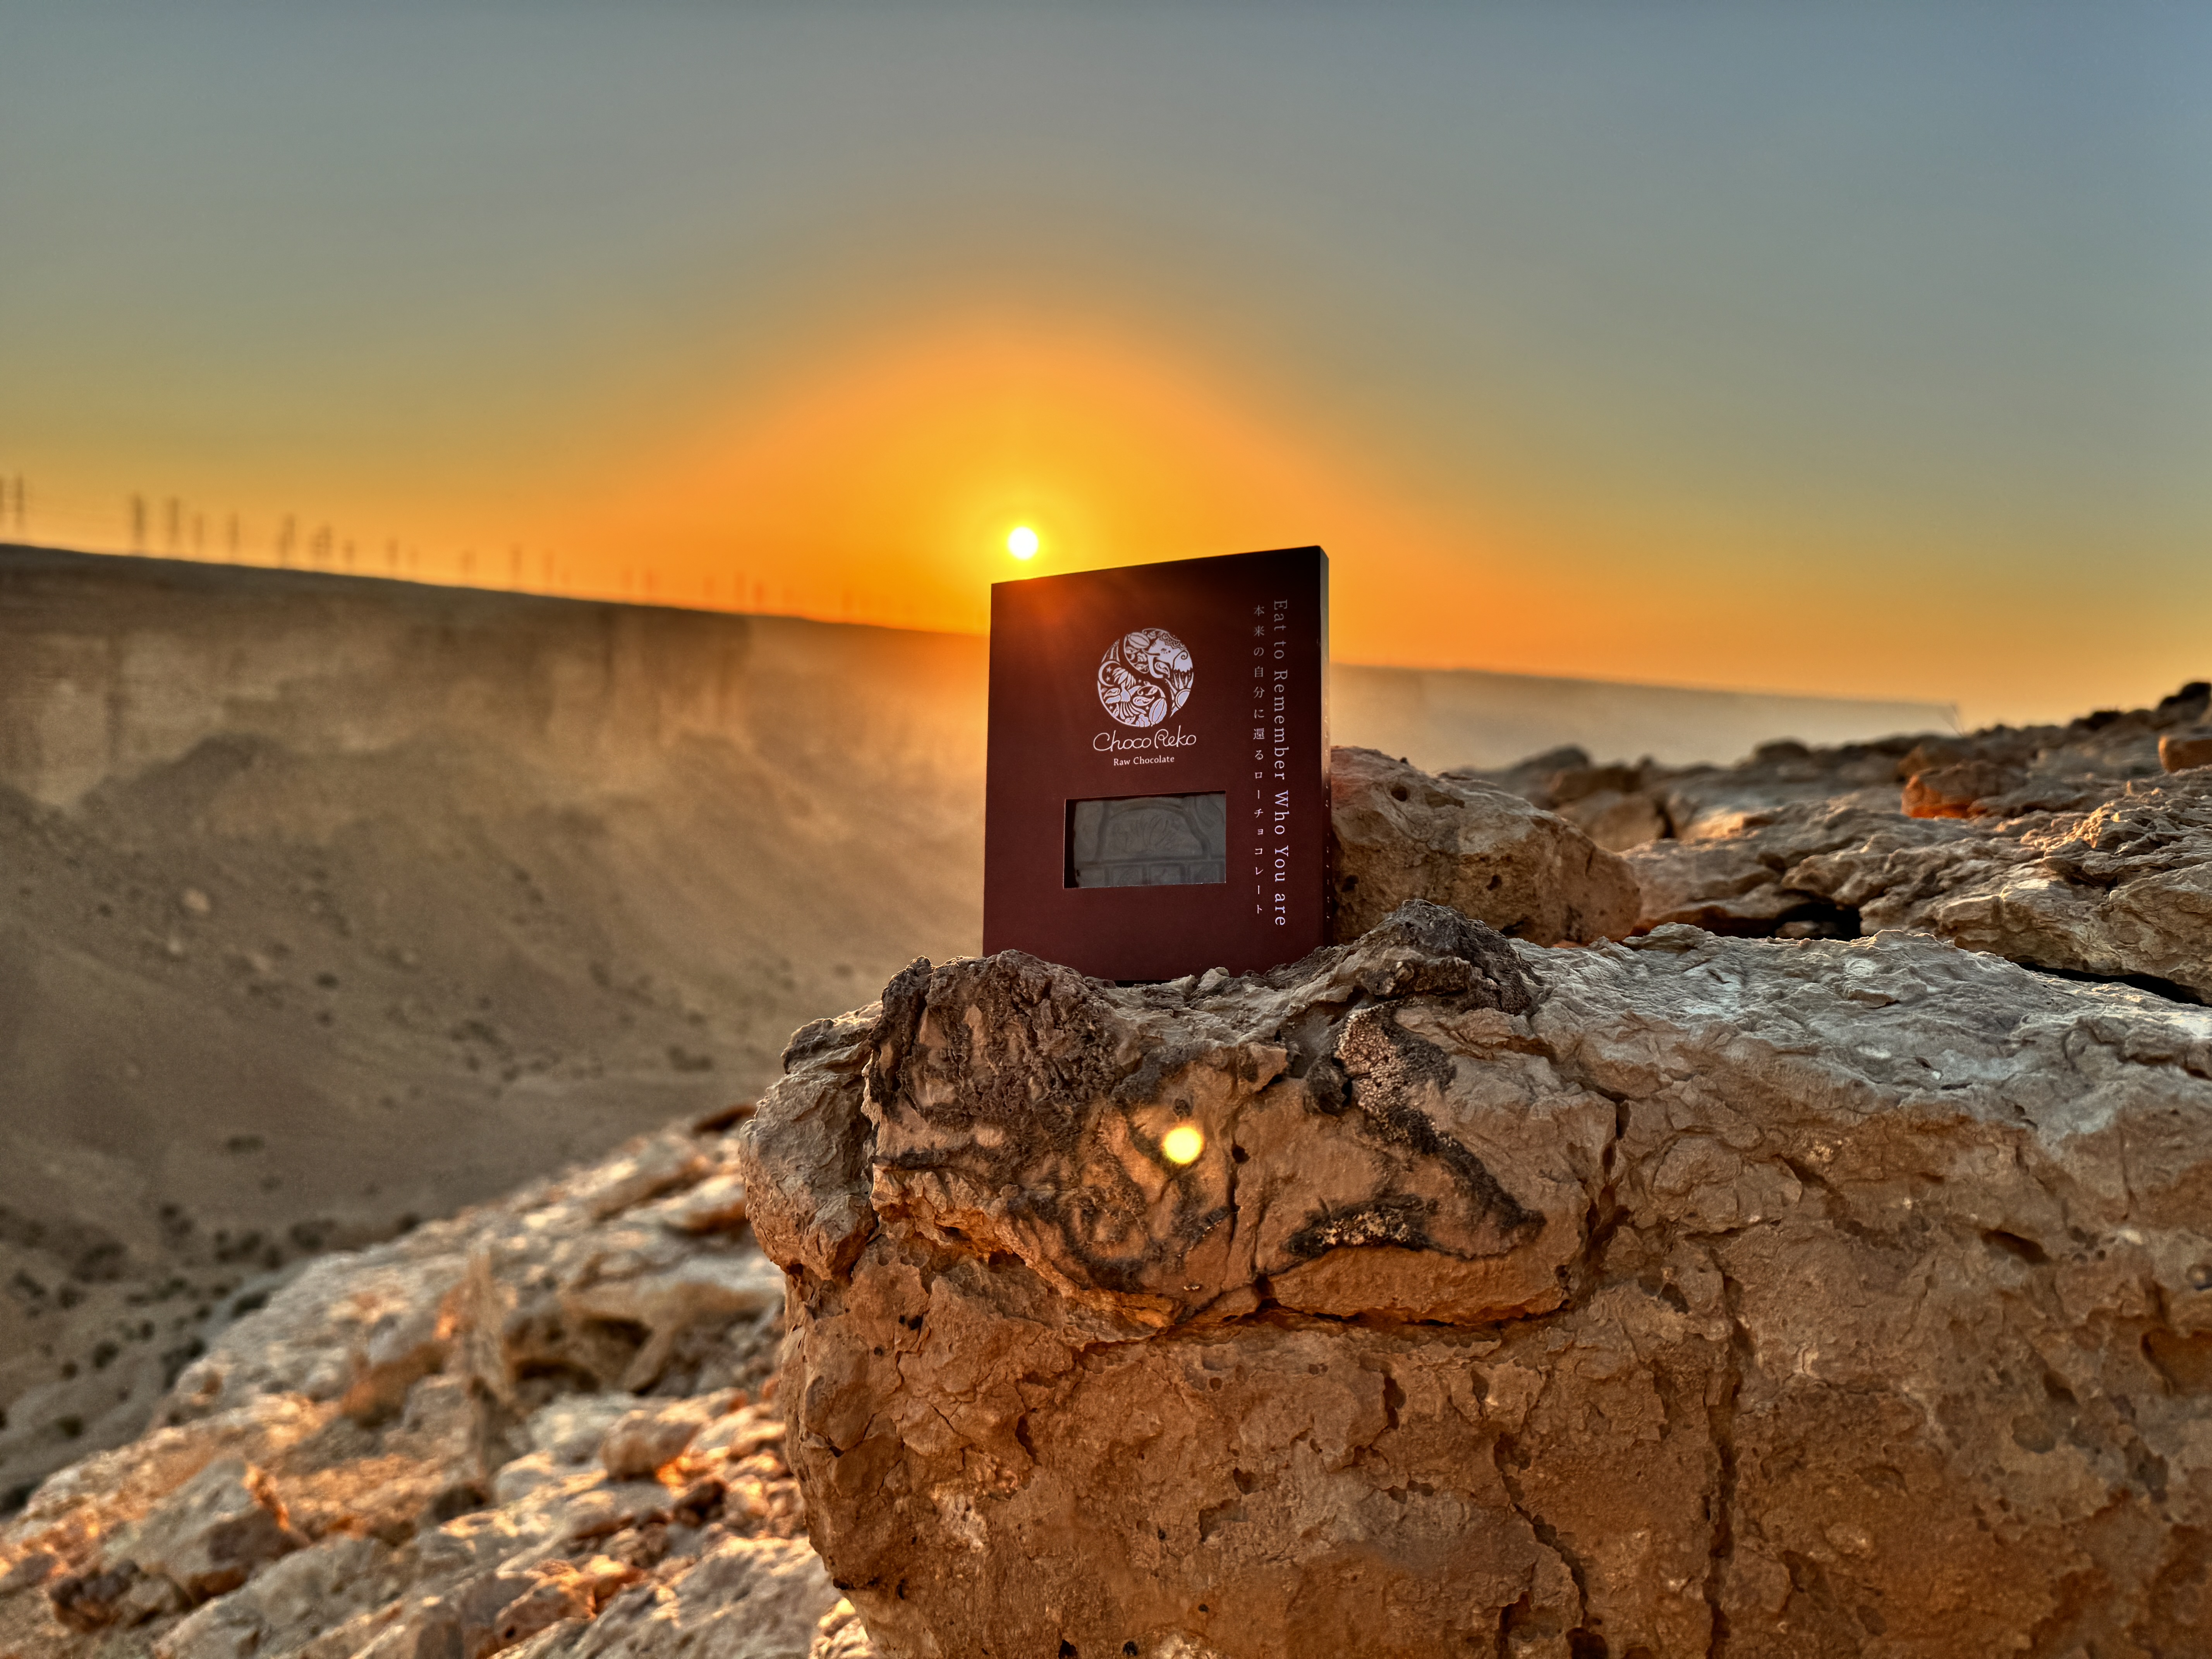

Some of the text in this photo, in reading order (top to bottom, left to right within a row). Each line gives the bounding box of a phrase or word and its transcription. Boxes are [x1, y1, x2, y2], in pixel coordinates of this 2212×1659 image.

[1133, 755, 1174, 764] Chocolate
[1274, 599, 1289, 925] Eat to Remember Who You are
